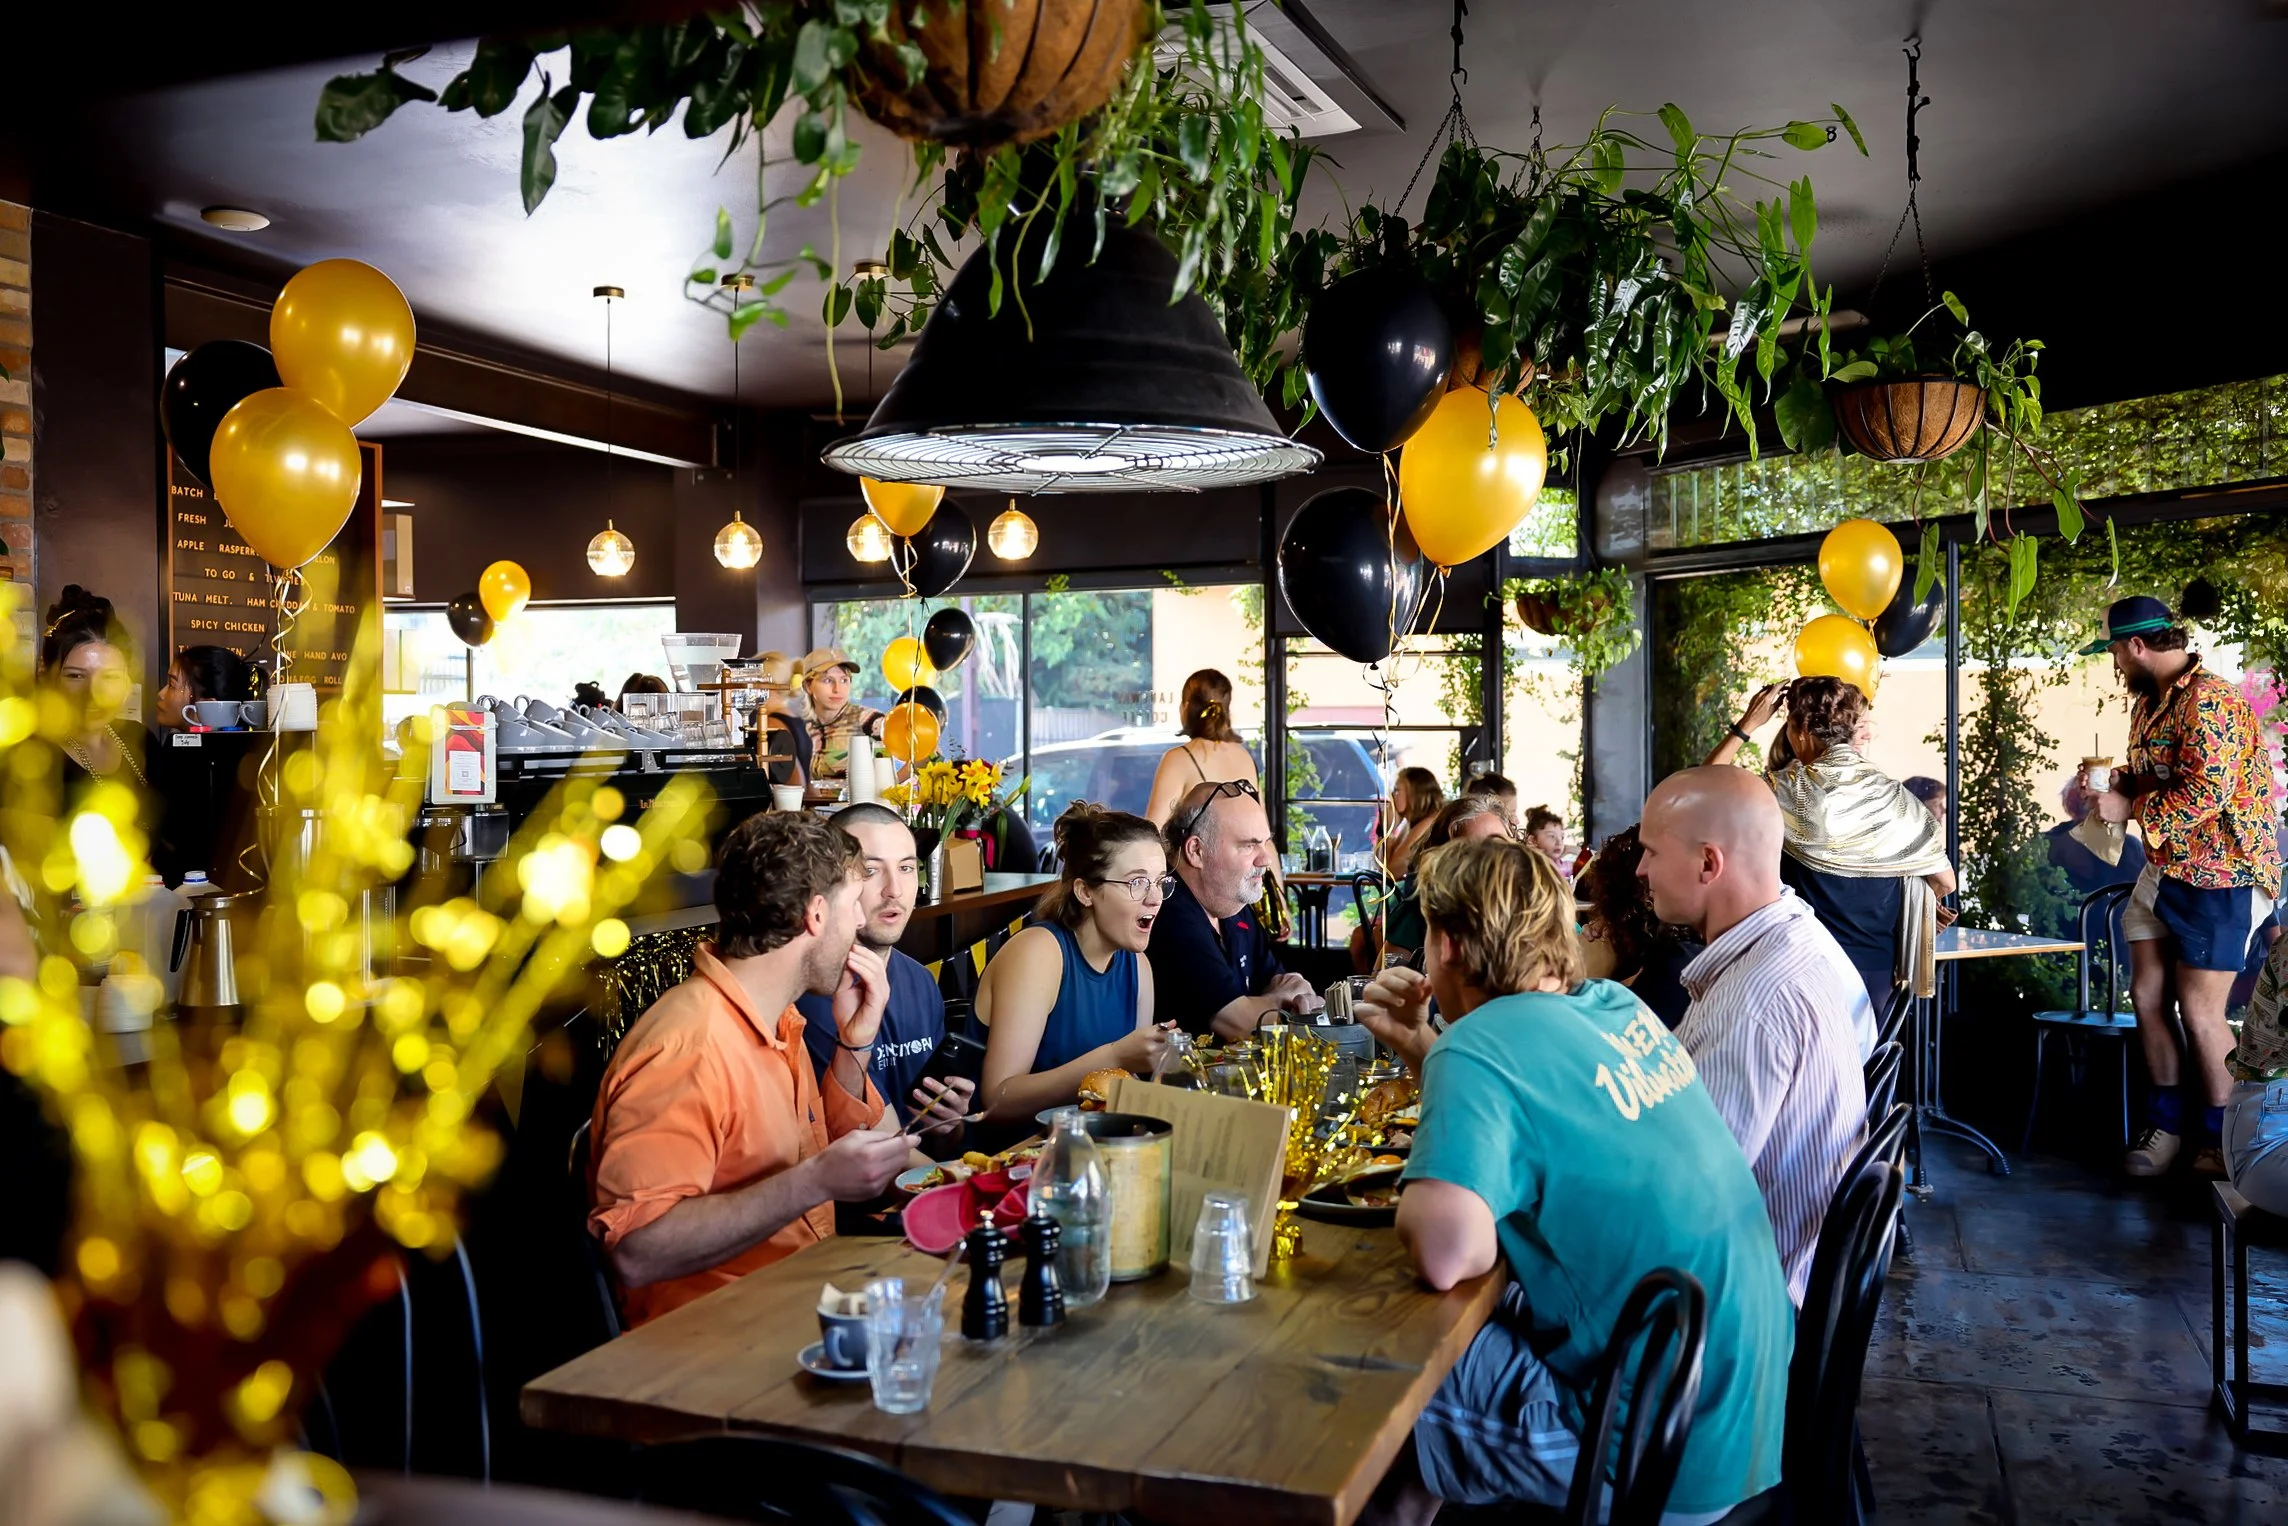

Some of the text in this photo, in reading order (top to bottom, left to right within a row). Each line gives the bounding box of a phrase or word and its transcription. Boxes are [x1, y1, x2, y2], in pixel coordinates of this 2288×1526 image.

[171, 485, 204, 498] BATCH
[178, 512, 207, 525] FRESH
[177, 539, 205, 551] APPLE
[204, 567, 218, 578] TO
[222, 569, 236, 580] GO
[248, 572, 255, 582] &
[173, 591, 198, 603] TUNA
[205, 594, 233, 605] MELT.
[246, 597, 266, 607] HAM
[323, 603, 355, 614] TOMATO
[191, 619, 265, 633] SPICY CHICKEN
[303, 650, 327, 660] HAND
[330, 651, 348, 661] AVO
[323, 675, 342, 685] ROLL
